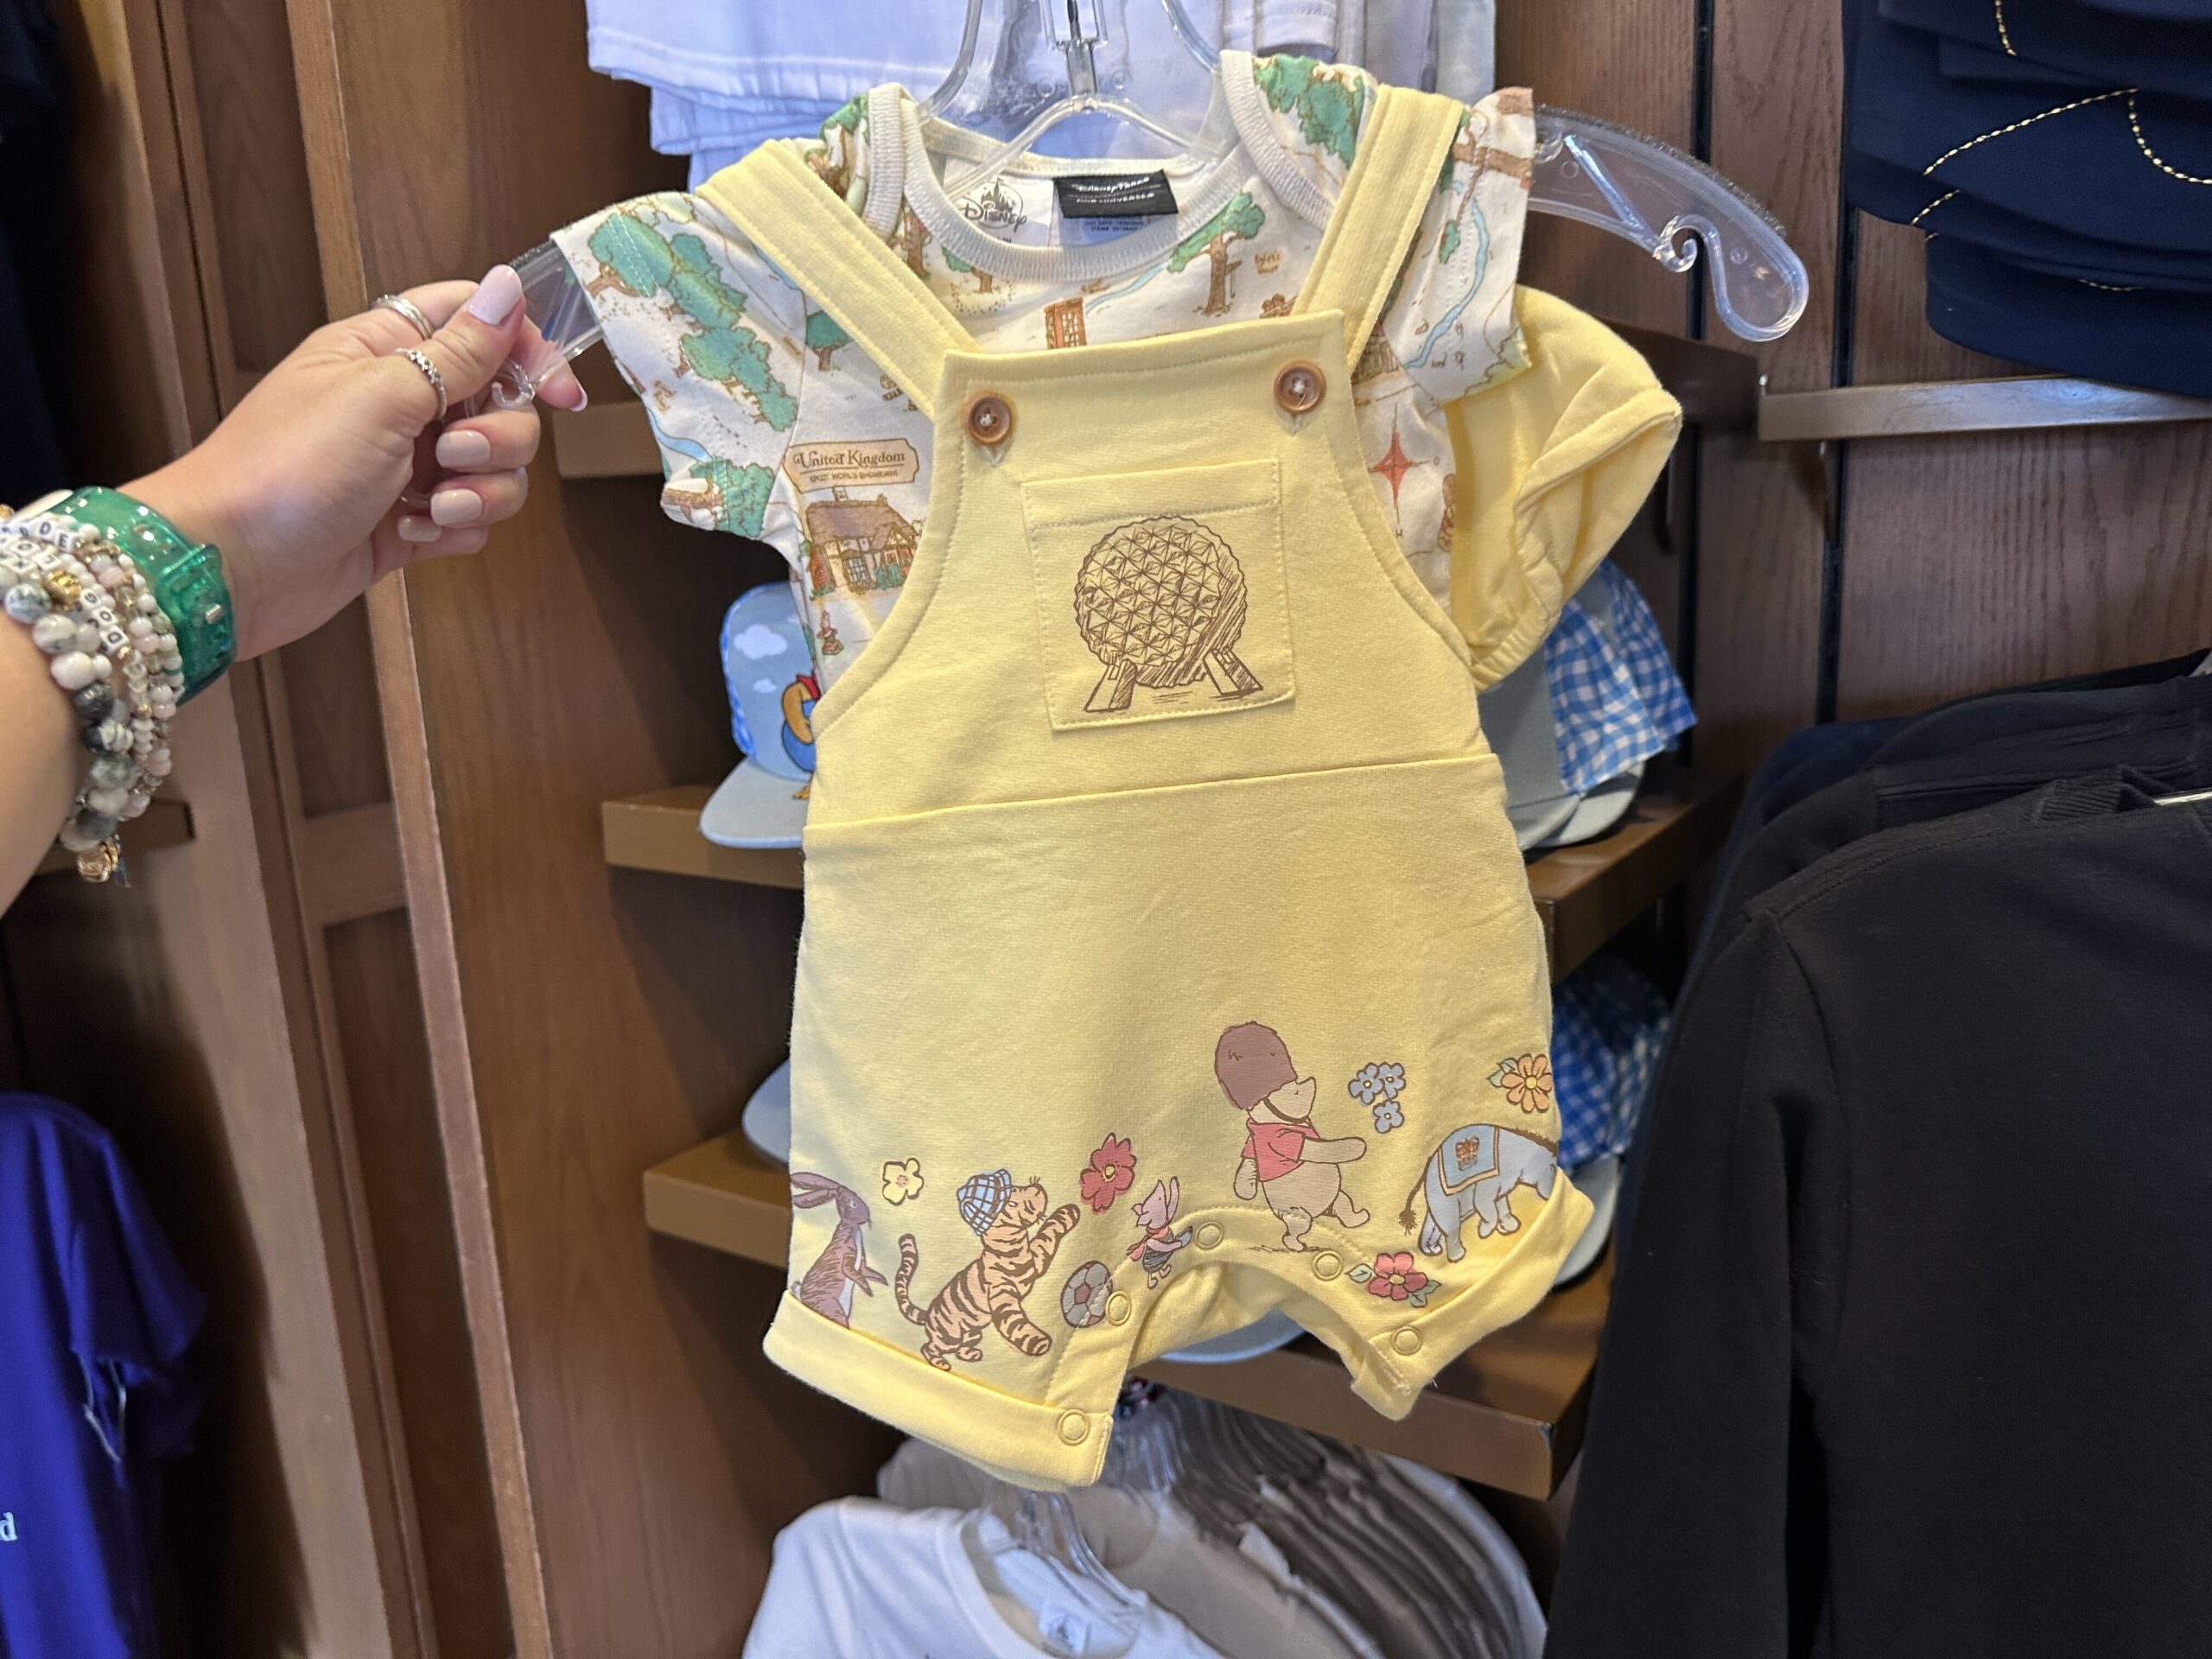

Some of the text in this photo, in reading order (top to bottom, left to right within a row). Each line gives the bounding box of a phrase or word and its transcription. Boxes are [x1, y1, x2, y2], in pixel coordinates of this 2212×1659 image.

[957, 197, 1027, 233] Disney
[792, 449, 906, 468] United Kingdom
